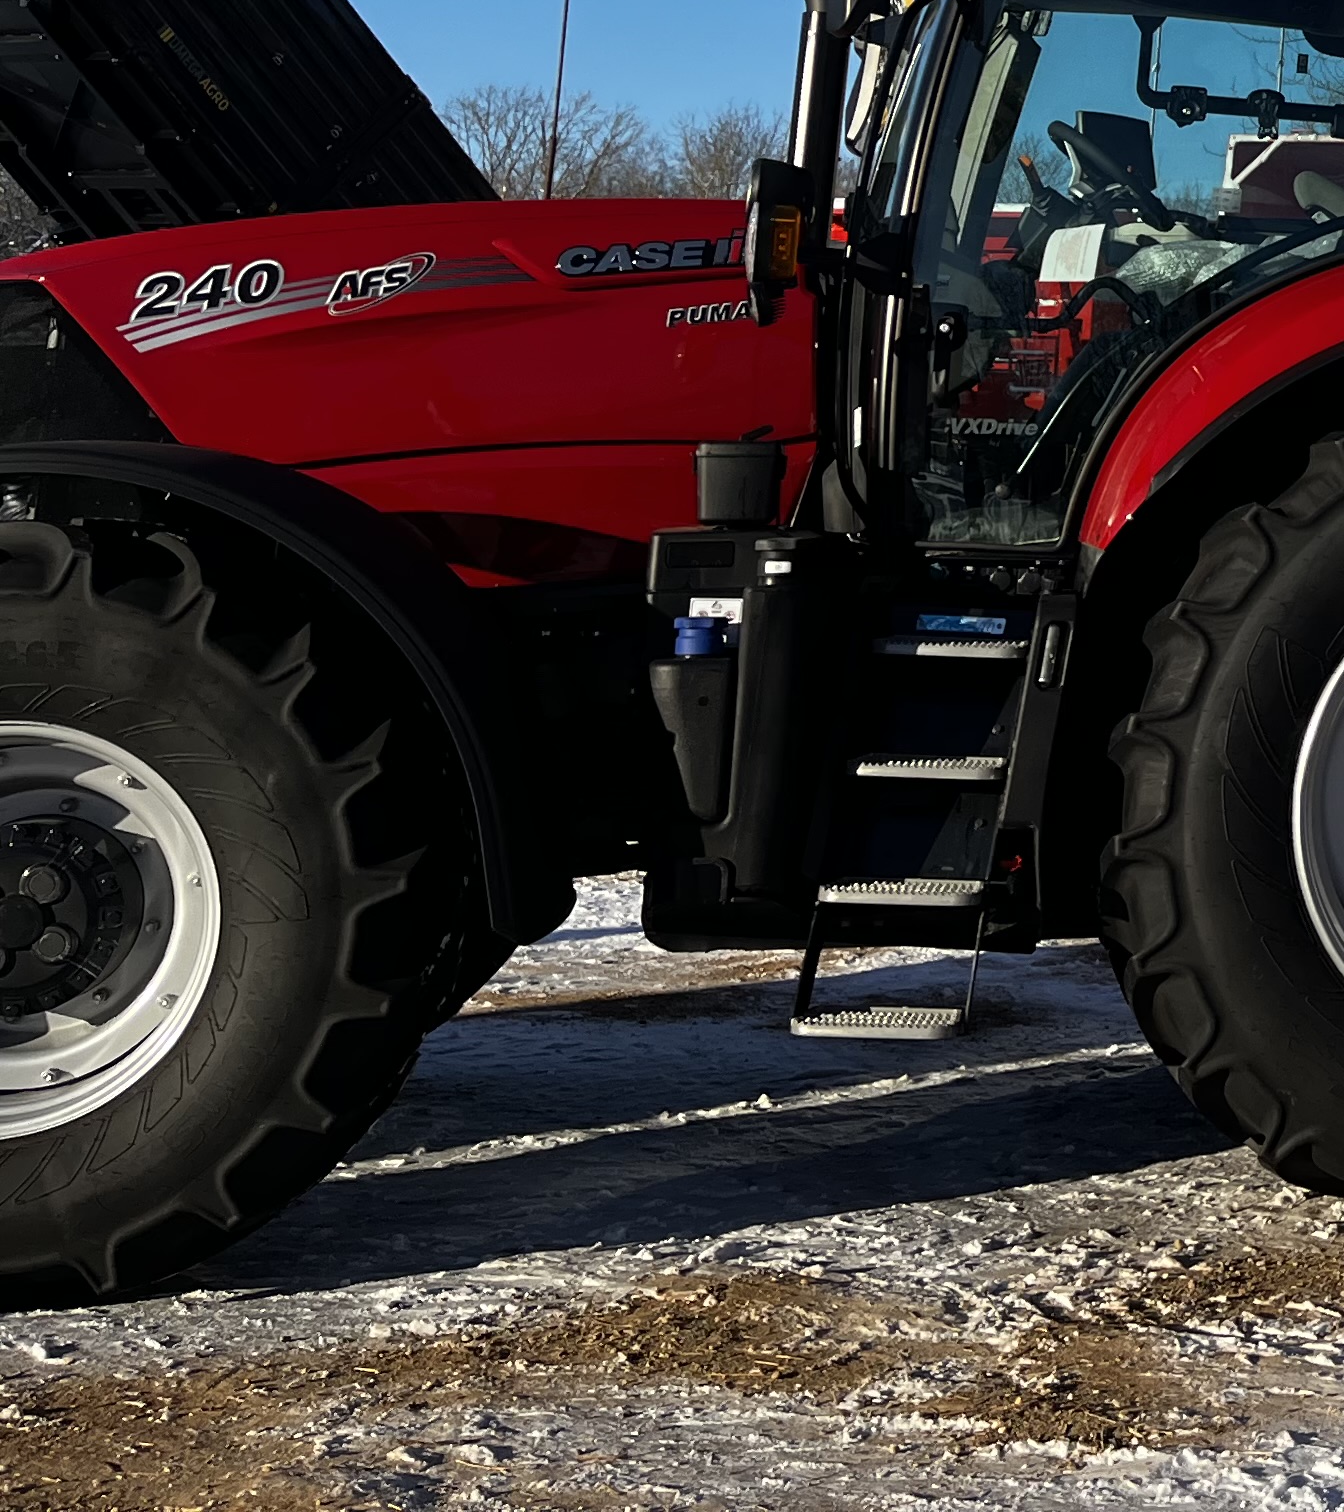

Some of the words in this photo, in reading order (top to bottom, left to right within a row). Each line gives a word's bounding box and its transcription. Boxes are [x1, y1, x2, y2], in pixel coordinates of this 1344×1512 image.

[556, 240, 706, 276] CASE
[129, 259, 285, 324] 240
[324, 261, 414, 307] AFS
[666, 300, 750, 328] PUMA
